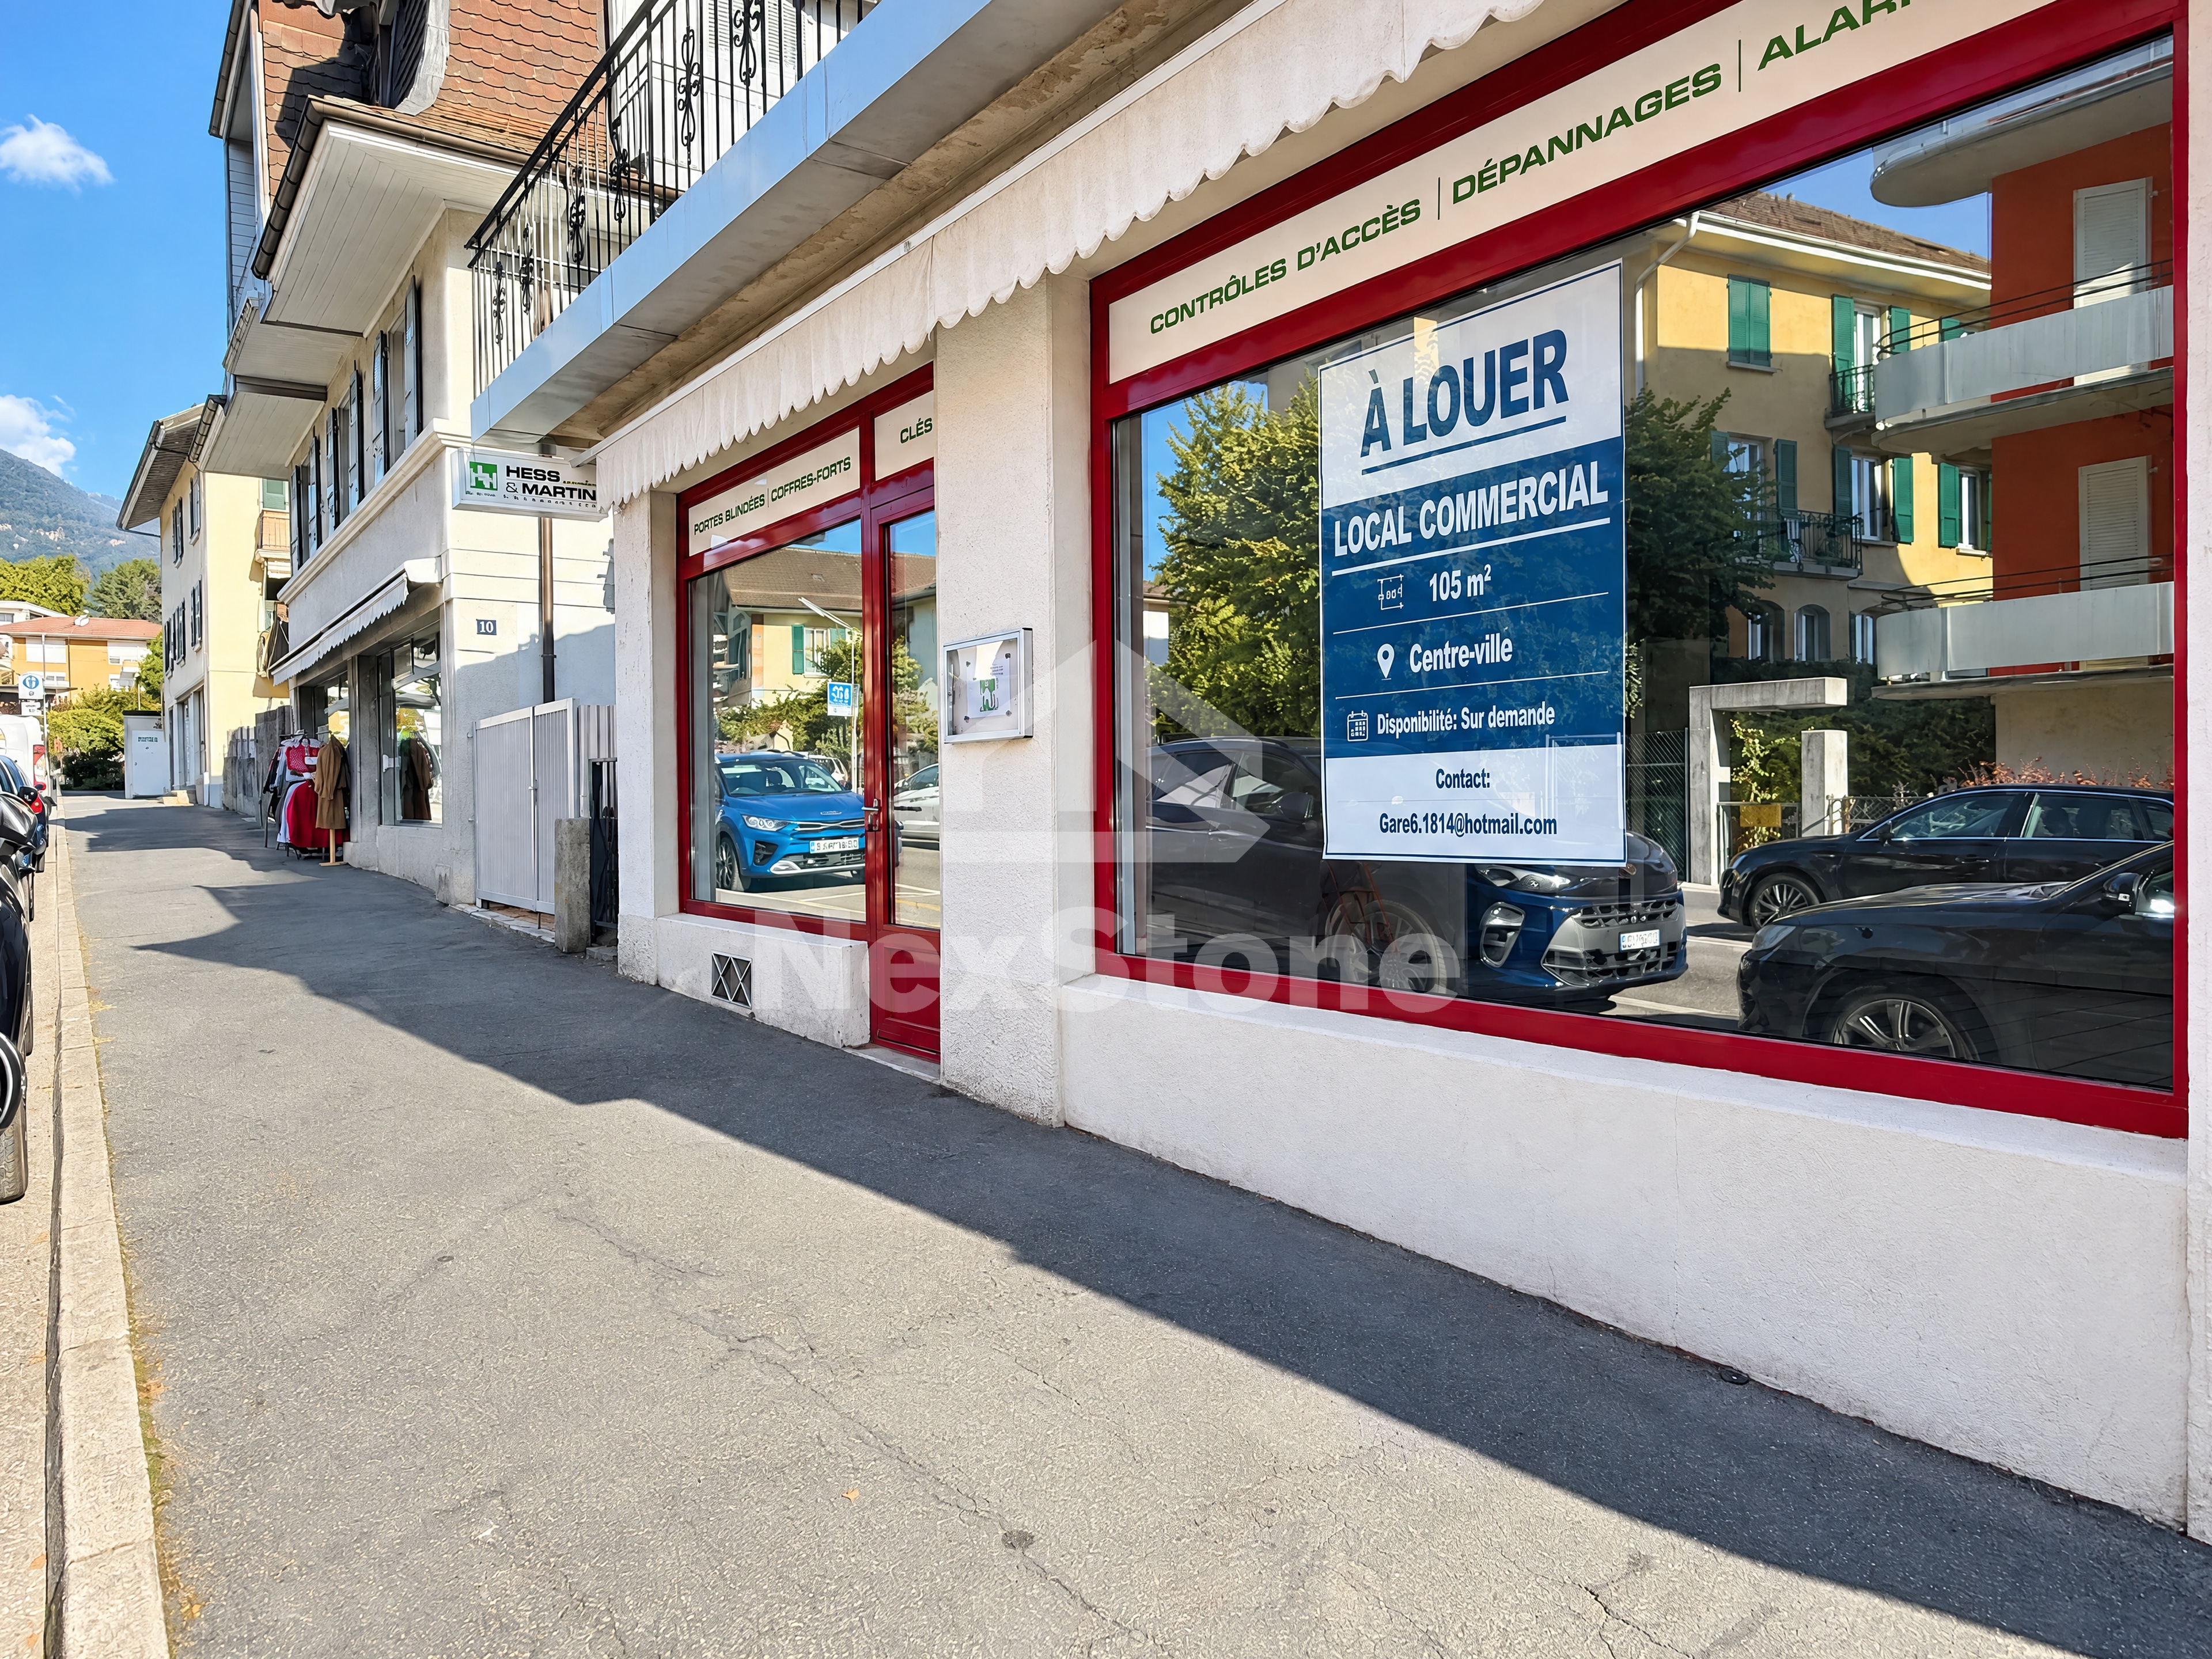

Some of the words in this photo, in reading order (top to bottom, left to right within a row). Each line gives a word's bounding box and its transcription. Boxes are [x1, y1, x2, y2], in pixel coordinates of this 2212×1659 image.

[1758, 0, 1910, 71] ALAR
[1452, 62, 1722, 204] DÉPANNAGES
[1150, 257, 1287, 335] CONTRÔLES
[1297, 199, 1421, 272] D'ACCÈS
[1360, 368, 1392, 458] À
[1403, 329, 1569, 446] LOUER
[900, 417, 933, 444] CLÉS
[506, 465, 560, 482] HESS
[506, 482, 518, 493] &
[522, 483, 596, 501] MARTIN
[771, 456, 851, 502] COFFRES-FORTS
[694, 513, 724, 535] PORTES
[725, 493, 766, 522] BLINDÉES
[1334, 505, 1412, 556] LOCAL
[1419, 460, 1609, 540] COMMERCIAL
[1429, 570, 1461, 602] 105
[480, 621, 494, 632] 10
[1410, 633, 1513, 673] Centre-ville
[1377, 707, 1457, 738] Disponibilité:
[1460, 707, 1484, 729] Sur
[1487, 701, 1555, 728] demande
[1435, 768, 1490, 789] Contact:
[1379, 812, 1557, 838] Gare6.1814@hotmail.com
